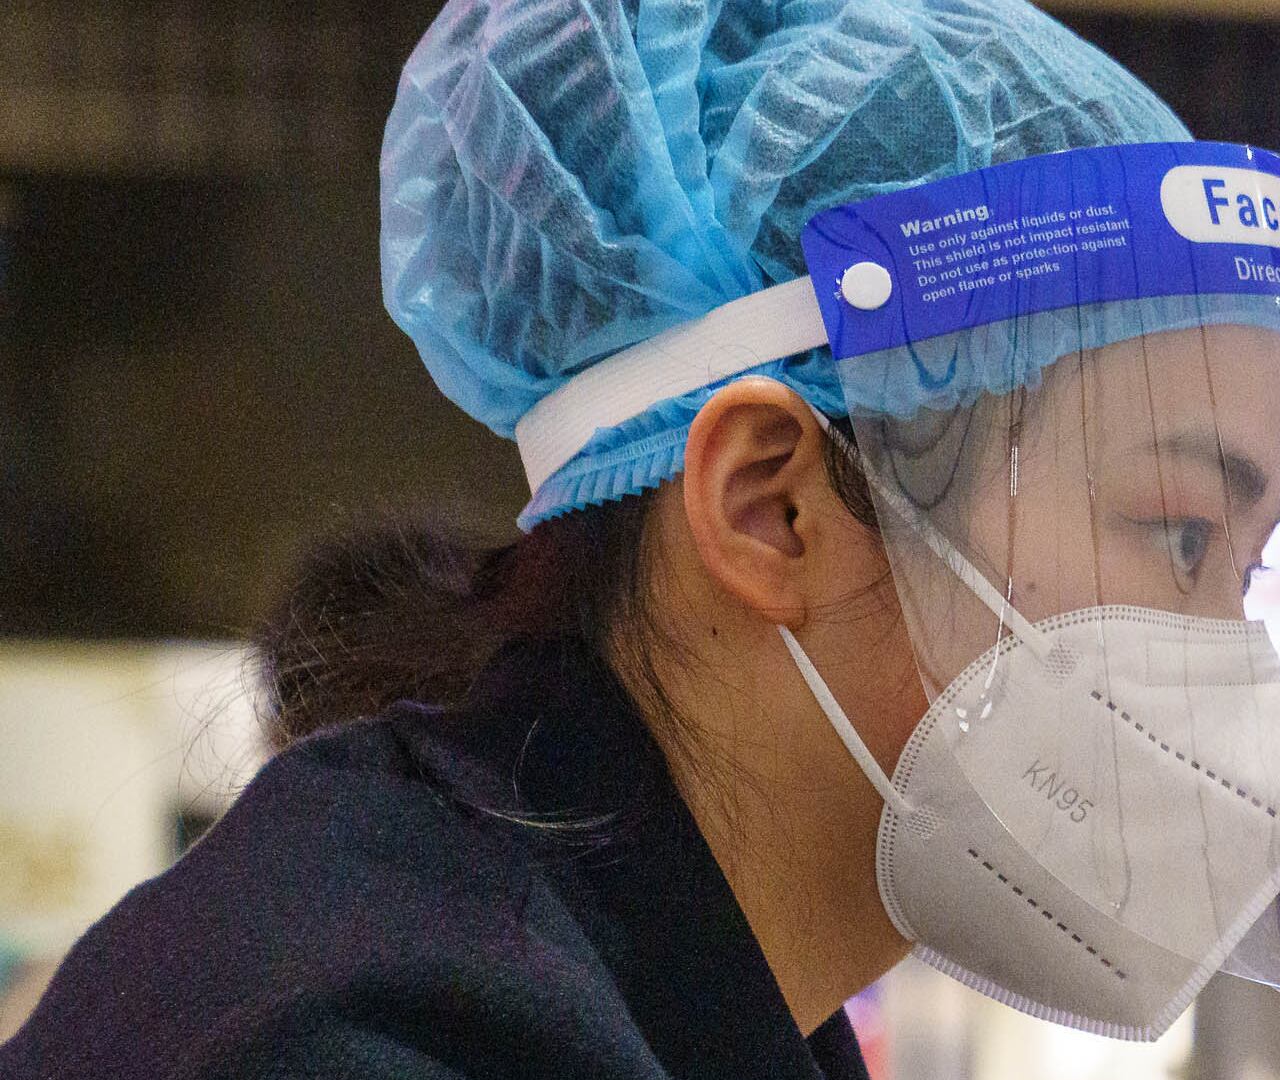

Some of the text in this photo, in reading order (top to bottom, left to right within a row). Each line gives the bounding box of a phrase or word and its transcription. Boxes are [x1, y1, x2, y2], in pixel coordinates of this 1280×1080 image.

[909, 204, 1117, 257] Use only against liquids or dust.
[913, 255, 942, 272] This
[945, 244, 986, 263] shield
[989, 239, 1001, 251] is
[1004, 234, 1026, 248] not
[1029, 226, 1073, 244] impact
[918, 236, 1127, 287] Do not use as protection against
[922, 262, 1060, 302] open flame or sparks
[1022, 760, 1094, 823] KN95
